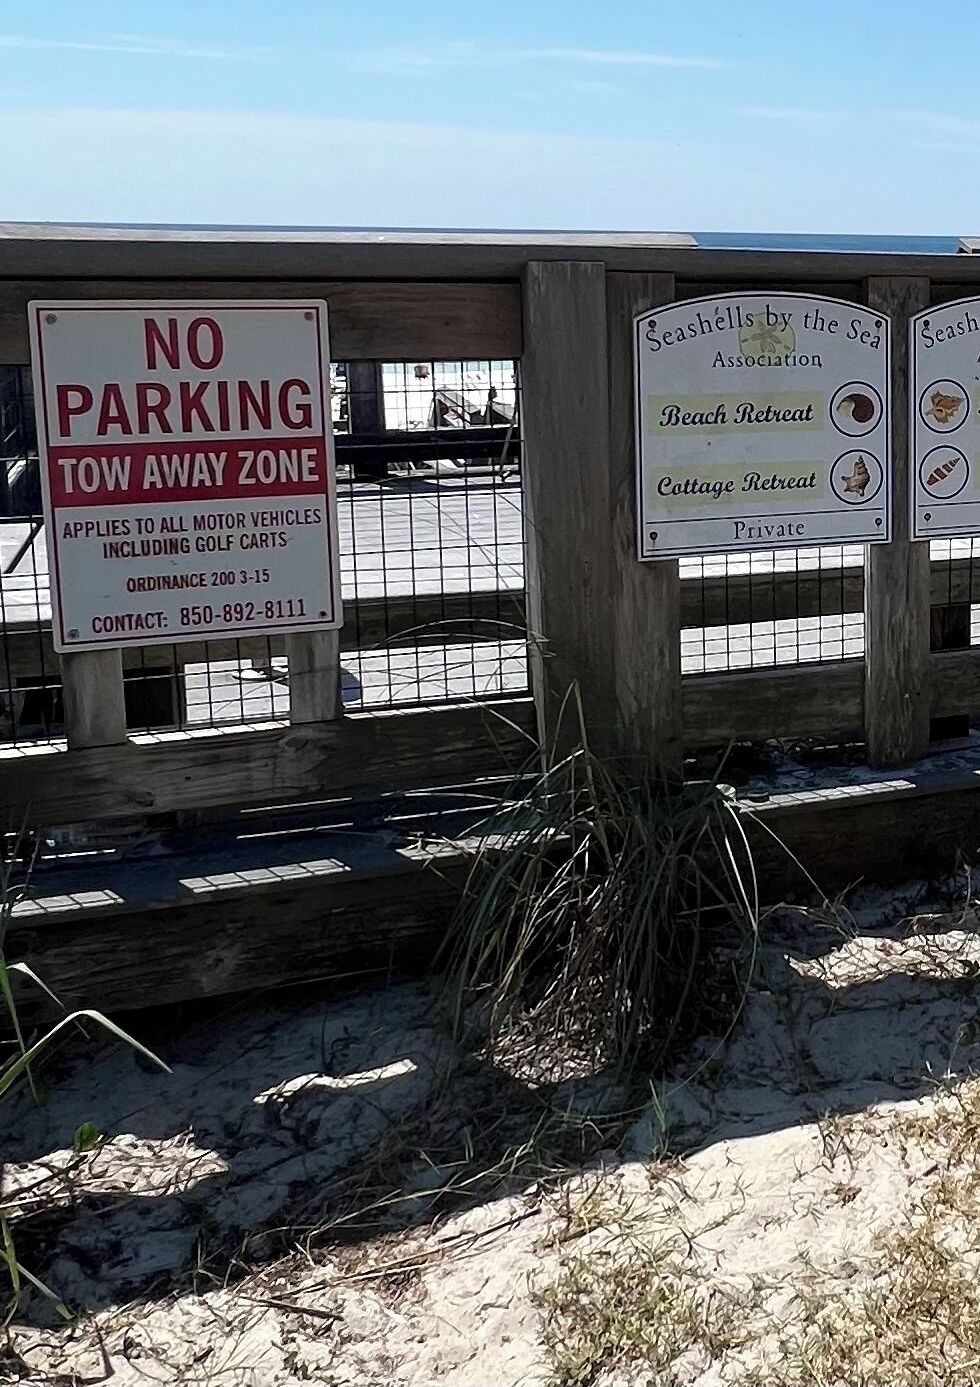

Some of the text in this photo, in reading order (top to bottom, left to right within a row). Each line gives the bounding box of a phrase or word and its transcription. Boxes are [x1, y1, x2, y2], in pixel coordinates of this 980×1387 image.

[645, 304, 882, 352] Seashells by the Sea
[144, 317, 225, 370] NO
[712, 350, 823, 369] Association
[56, 379, 313, 438] PARKING
[659, 402, 814, 427] Beach Retreat
[58, 448, 319, 494] TOW AWAY ZONE
[657, 472, 817, 499] Cottage Retreat
[63, 508, 321, 539] APPLIES TO ALL MOTOR VEHICLES
[733, 520, 806, 540] Private
[103, 531, 288, 559] INCLUDING GOLF CARTS
[126, 569, 270, 593] ORDINANCE 200 3-15
[92, 599, 307, 634] CONTACT: 850-892-8111
